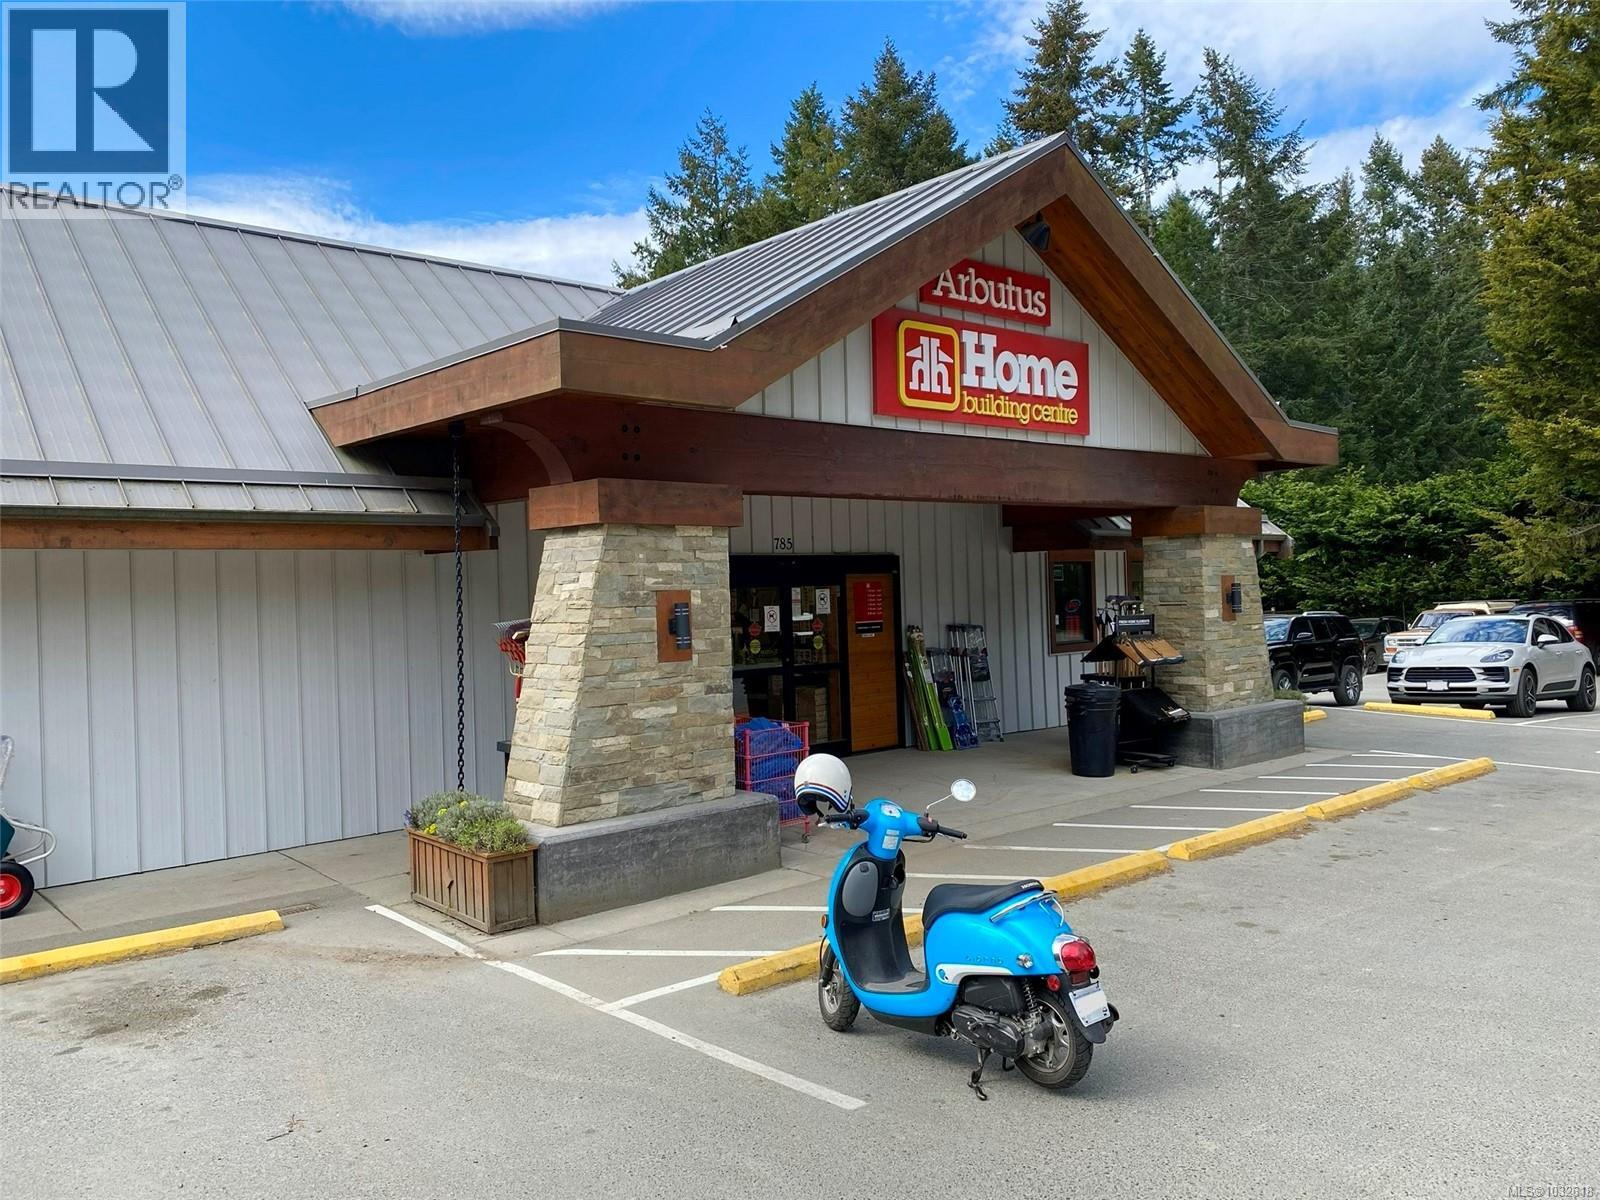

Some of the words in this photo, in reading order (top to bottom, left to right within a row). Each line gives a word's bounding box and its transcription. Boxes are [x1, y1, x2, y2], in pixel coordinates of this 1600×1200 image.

[931, 267, 1047, 318] Arbutus
[961, 329, 1079, 401] Home
[962, 391, 1031, 425] building
[1032, 402, 1079, 425] centre
[774, 537, 792, 551] 785
